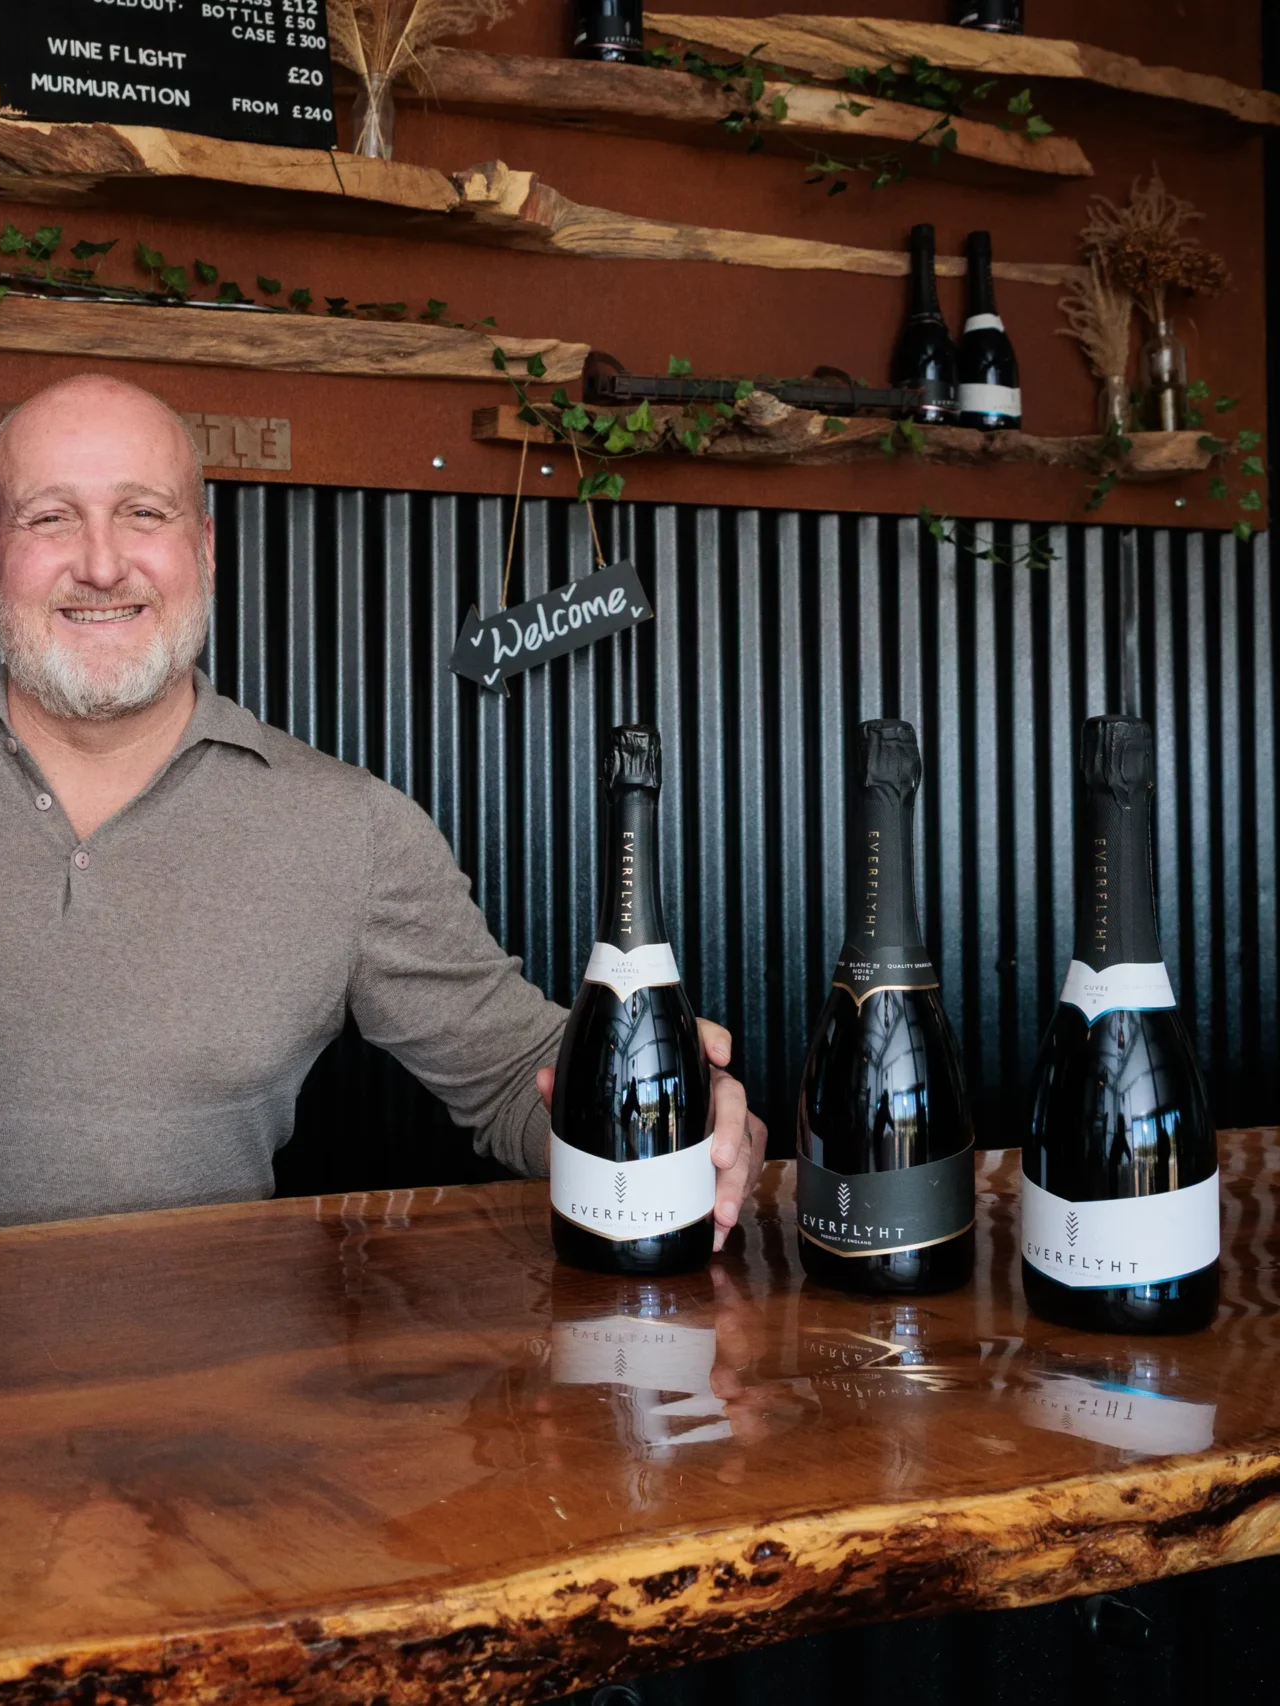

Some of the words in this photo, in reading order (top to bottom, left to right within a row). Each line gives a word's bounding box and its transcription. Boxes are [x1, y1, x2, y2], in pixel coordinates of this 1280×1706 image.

[202, 3, 275, 25] BOTTLE
[231, 26, 276, 43] CASE
[47, 37, 103, 61] WINE
[109, 45, 187, 70] FLIGHT
[288, 66, 324, 87] £20
[31, 73, 191, 107] MURMURATION
[232, 98, 279, 116] FROM
[491, 587, 628, 664] Welcome
[620, 831, 635, 935] EVERFLYHT
[863, 830, 880, 938] EVERFLYHT
[1093, 837, 1108, 953] EVERFLYHT
[571, 1203, 676, 1222] EVERFLYHT
[803, 1213, 905, 1240] EVERFLYHT
[820, 1233, 841, 1242] PRODUCT
[847, 1238, 872, 1246] ENGLAND
[1027, 1242, 1139, 1274] EVERFLYHT
